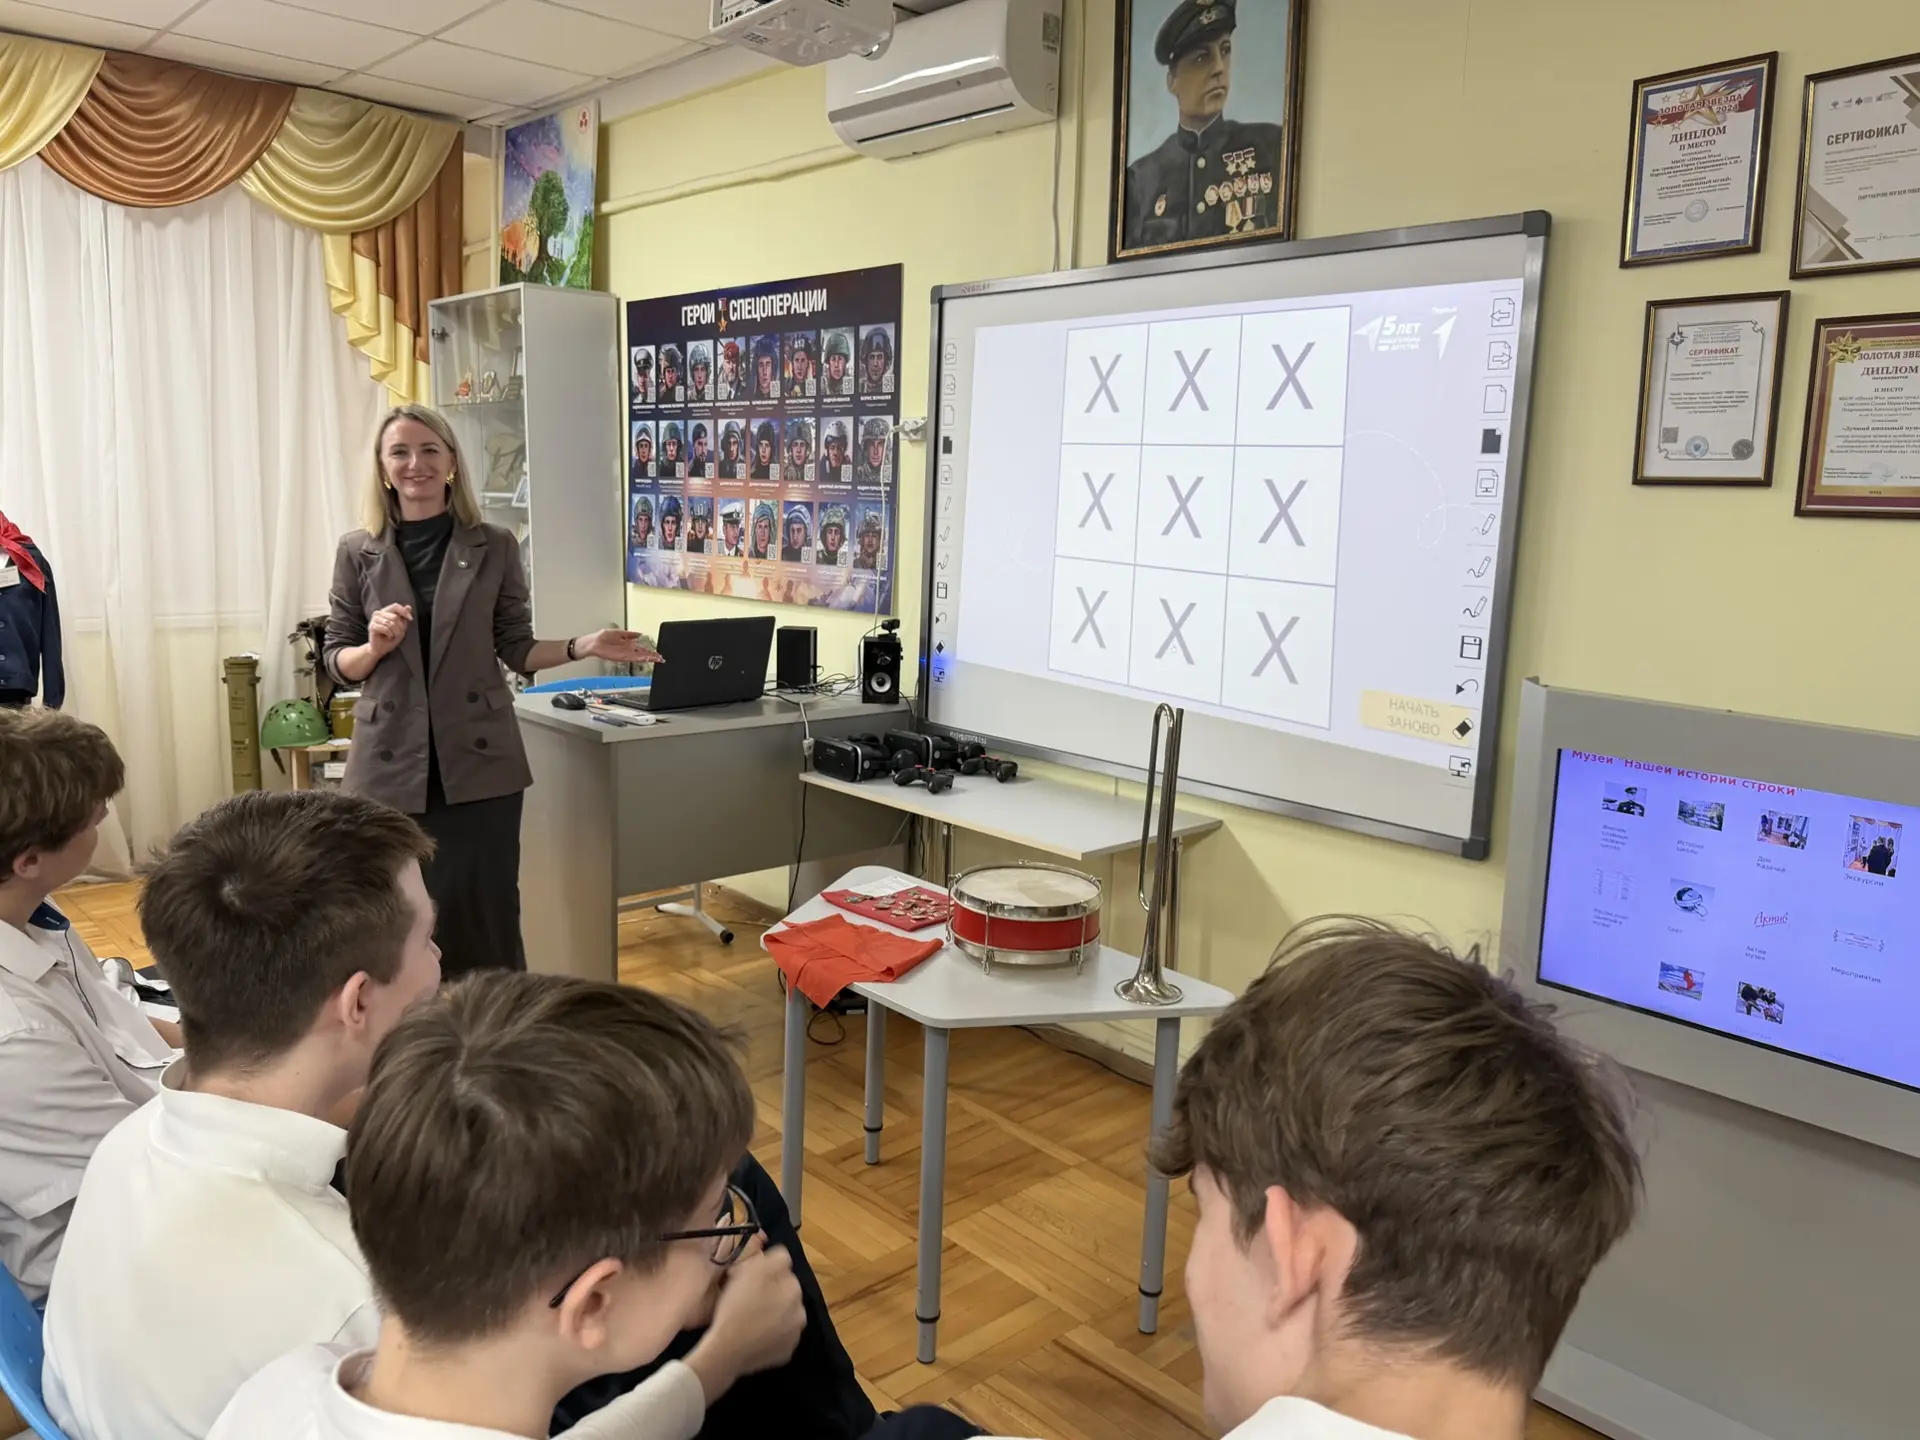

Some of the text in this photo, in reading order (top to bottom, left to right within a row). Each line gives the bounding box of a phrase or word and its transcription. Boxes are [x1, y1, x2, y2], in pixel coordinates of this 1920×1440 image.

[1703, 92, 1744, 107] ЗВЕЗДА
[1715, 103, 1738, 114] 2024
[1669, 125, 1727, 145] ДИПЛОМ
[1826, 122, 1907, 146] СЕРТИФИКАТ
[1687, 139, 1716, 150] МЕСТО
[681, 288, 828, 327] ГЕРОИ СПЕЦОПЕРАЦИИ
[1381, 315, 1422, 336] 5 ЛЕТ
[1688, 346, 1740, 357] СЕРТИФИКАТ
[1857, 350, 1901, 361] ЗОЛОТАЯ
[1861, 365, 1919, 377] ДИПЛОМ
[1389, 698, 1440, 718] НАЧАТЬ
[1387, 715, 1441, 737] ЗАНОВО
[1677, 767, 1737, 786] истории
[1844, 873, 1885, 887] Экскурсии
[1830, 965, 1882, 984] Мероприятия
